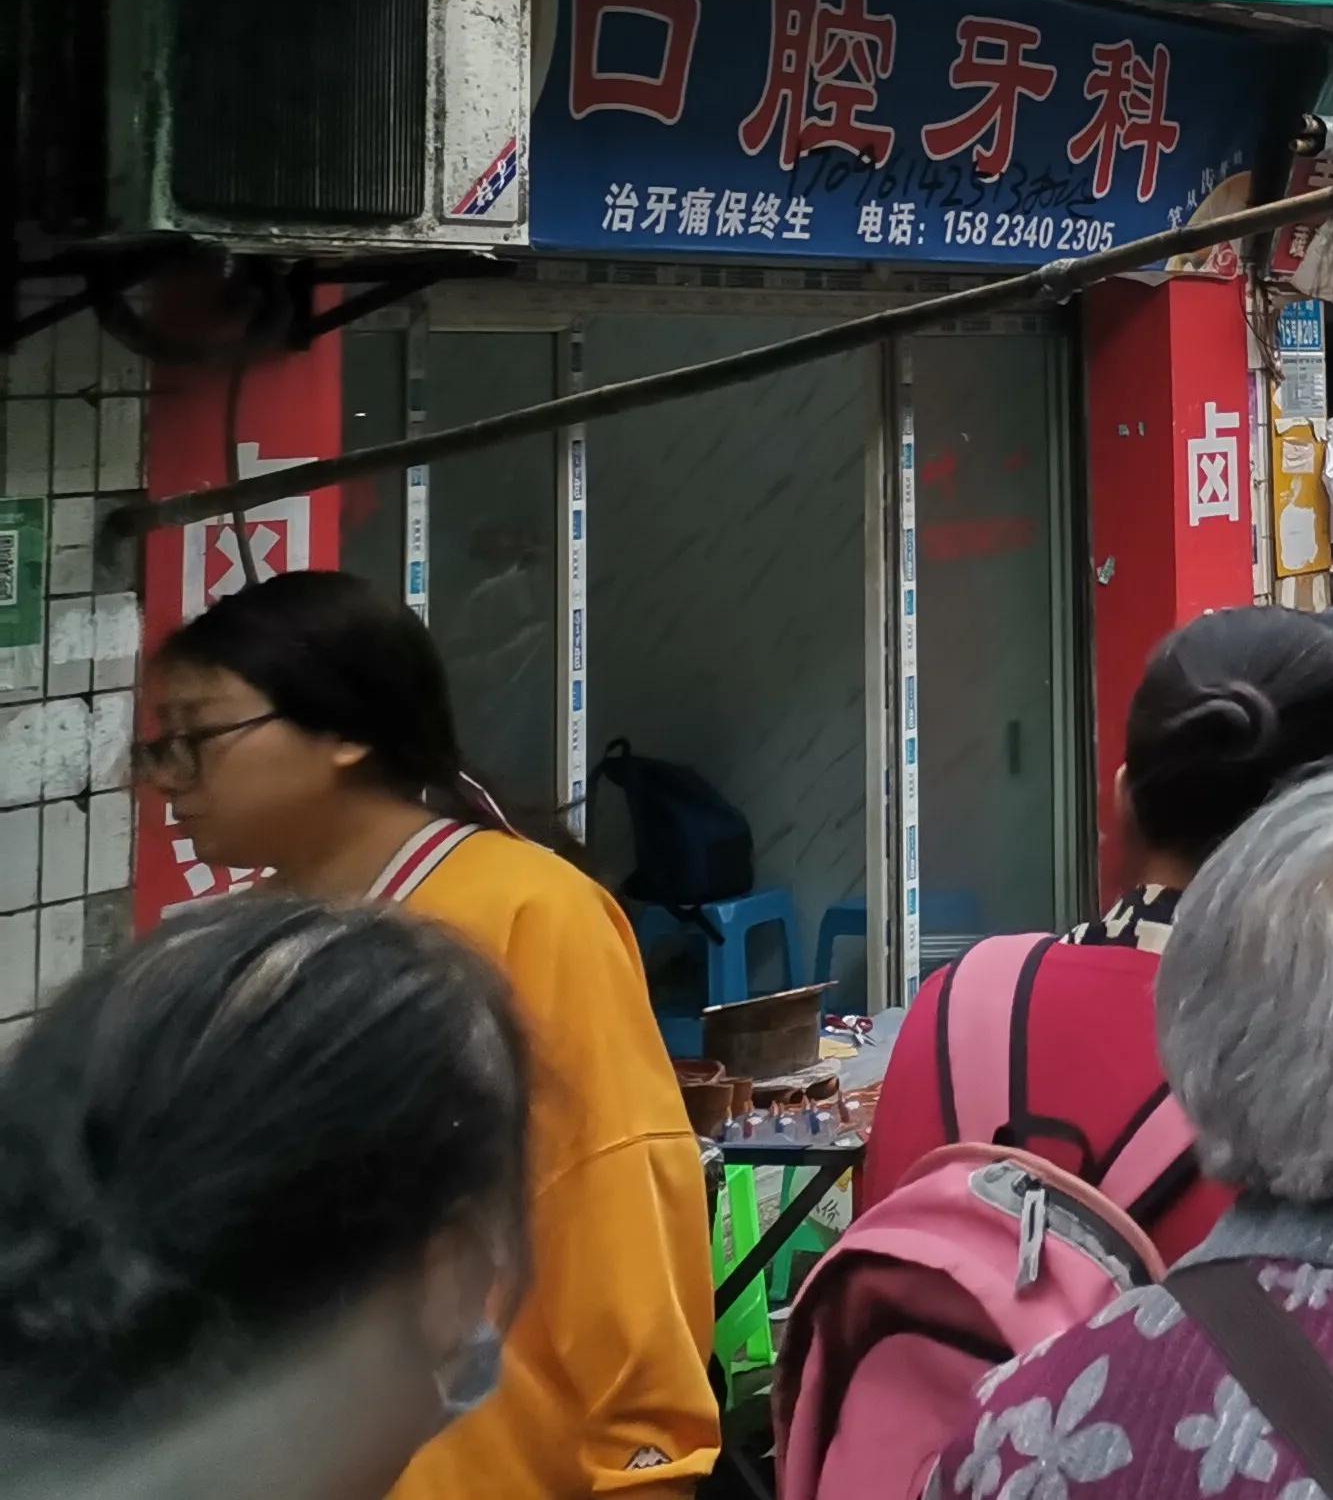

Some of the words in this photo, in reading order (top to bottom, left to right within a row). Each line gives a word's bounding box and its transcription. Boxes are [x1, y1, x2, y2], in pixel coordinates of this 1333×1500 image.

[601, 182, 815, 242] 治牙痛保终生
[942, 210, 988, 246] 158
[991, 213, 1054, 251] 2340
[1056, 217, 1117, 254] 2305
[1187, 401, 1241, 527] 卤
